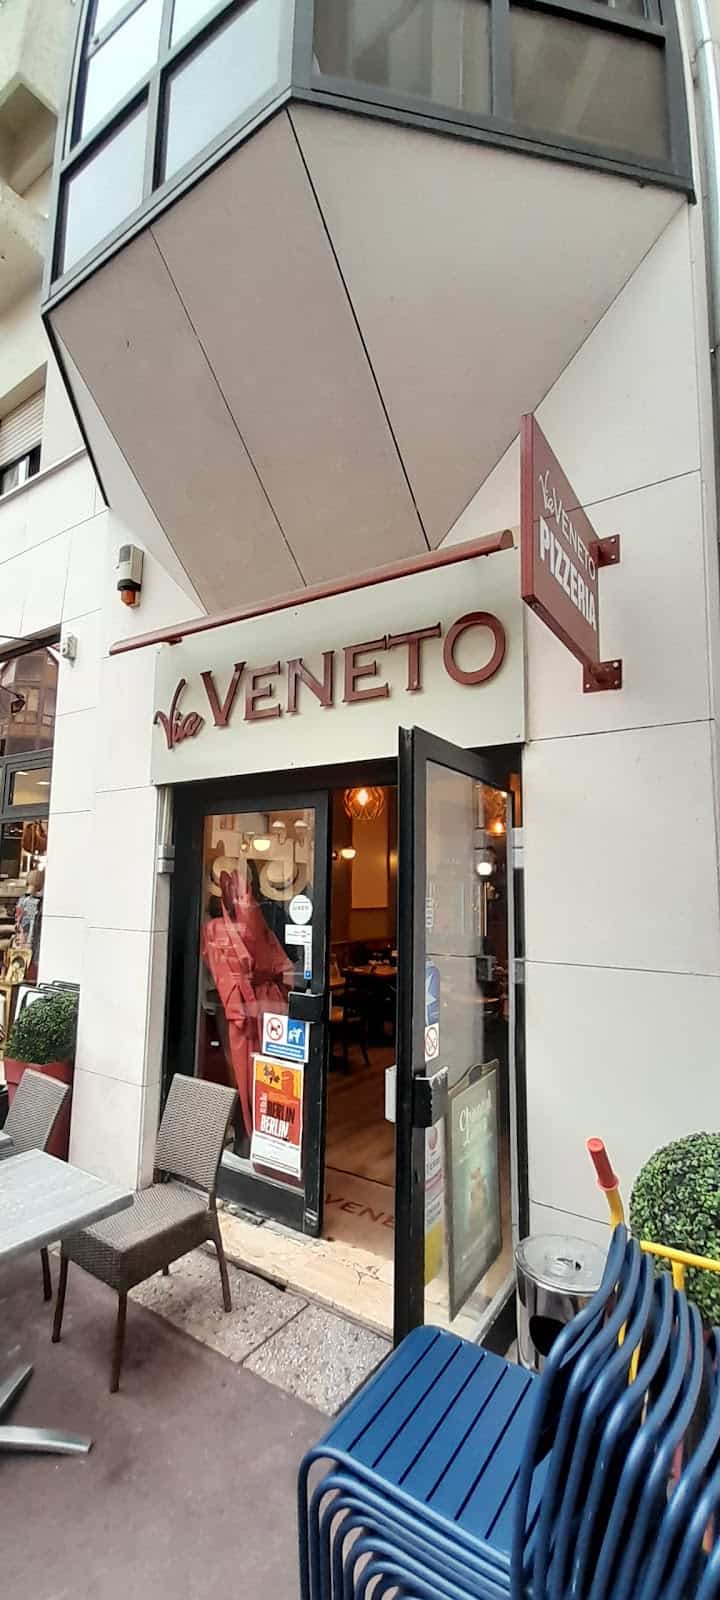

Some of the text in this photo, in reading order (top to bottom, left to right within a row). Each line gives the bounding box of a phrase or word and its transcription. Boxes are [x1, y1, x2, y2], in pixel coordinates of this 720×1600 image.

[539, 469, 597, 581] Via VENETO
[539, 515, 597, 631] PIZZERIA
[153, 610, 506, 750] Via VENETO
